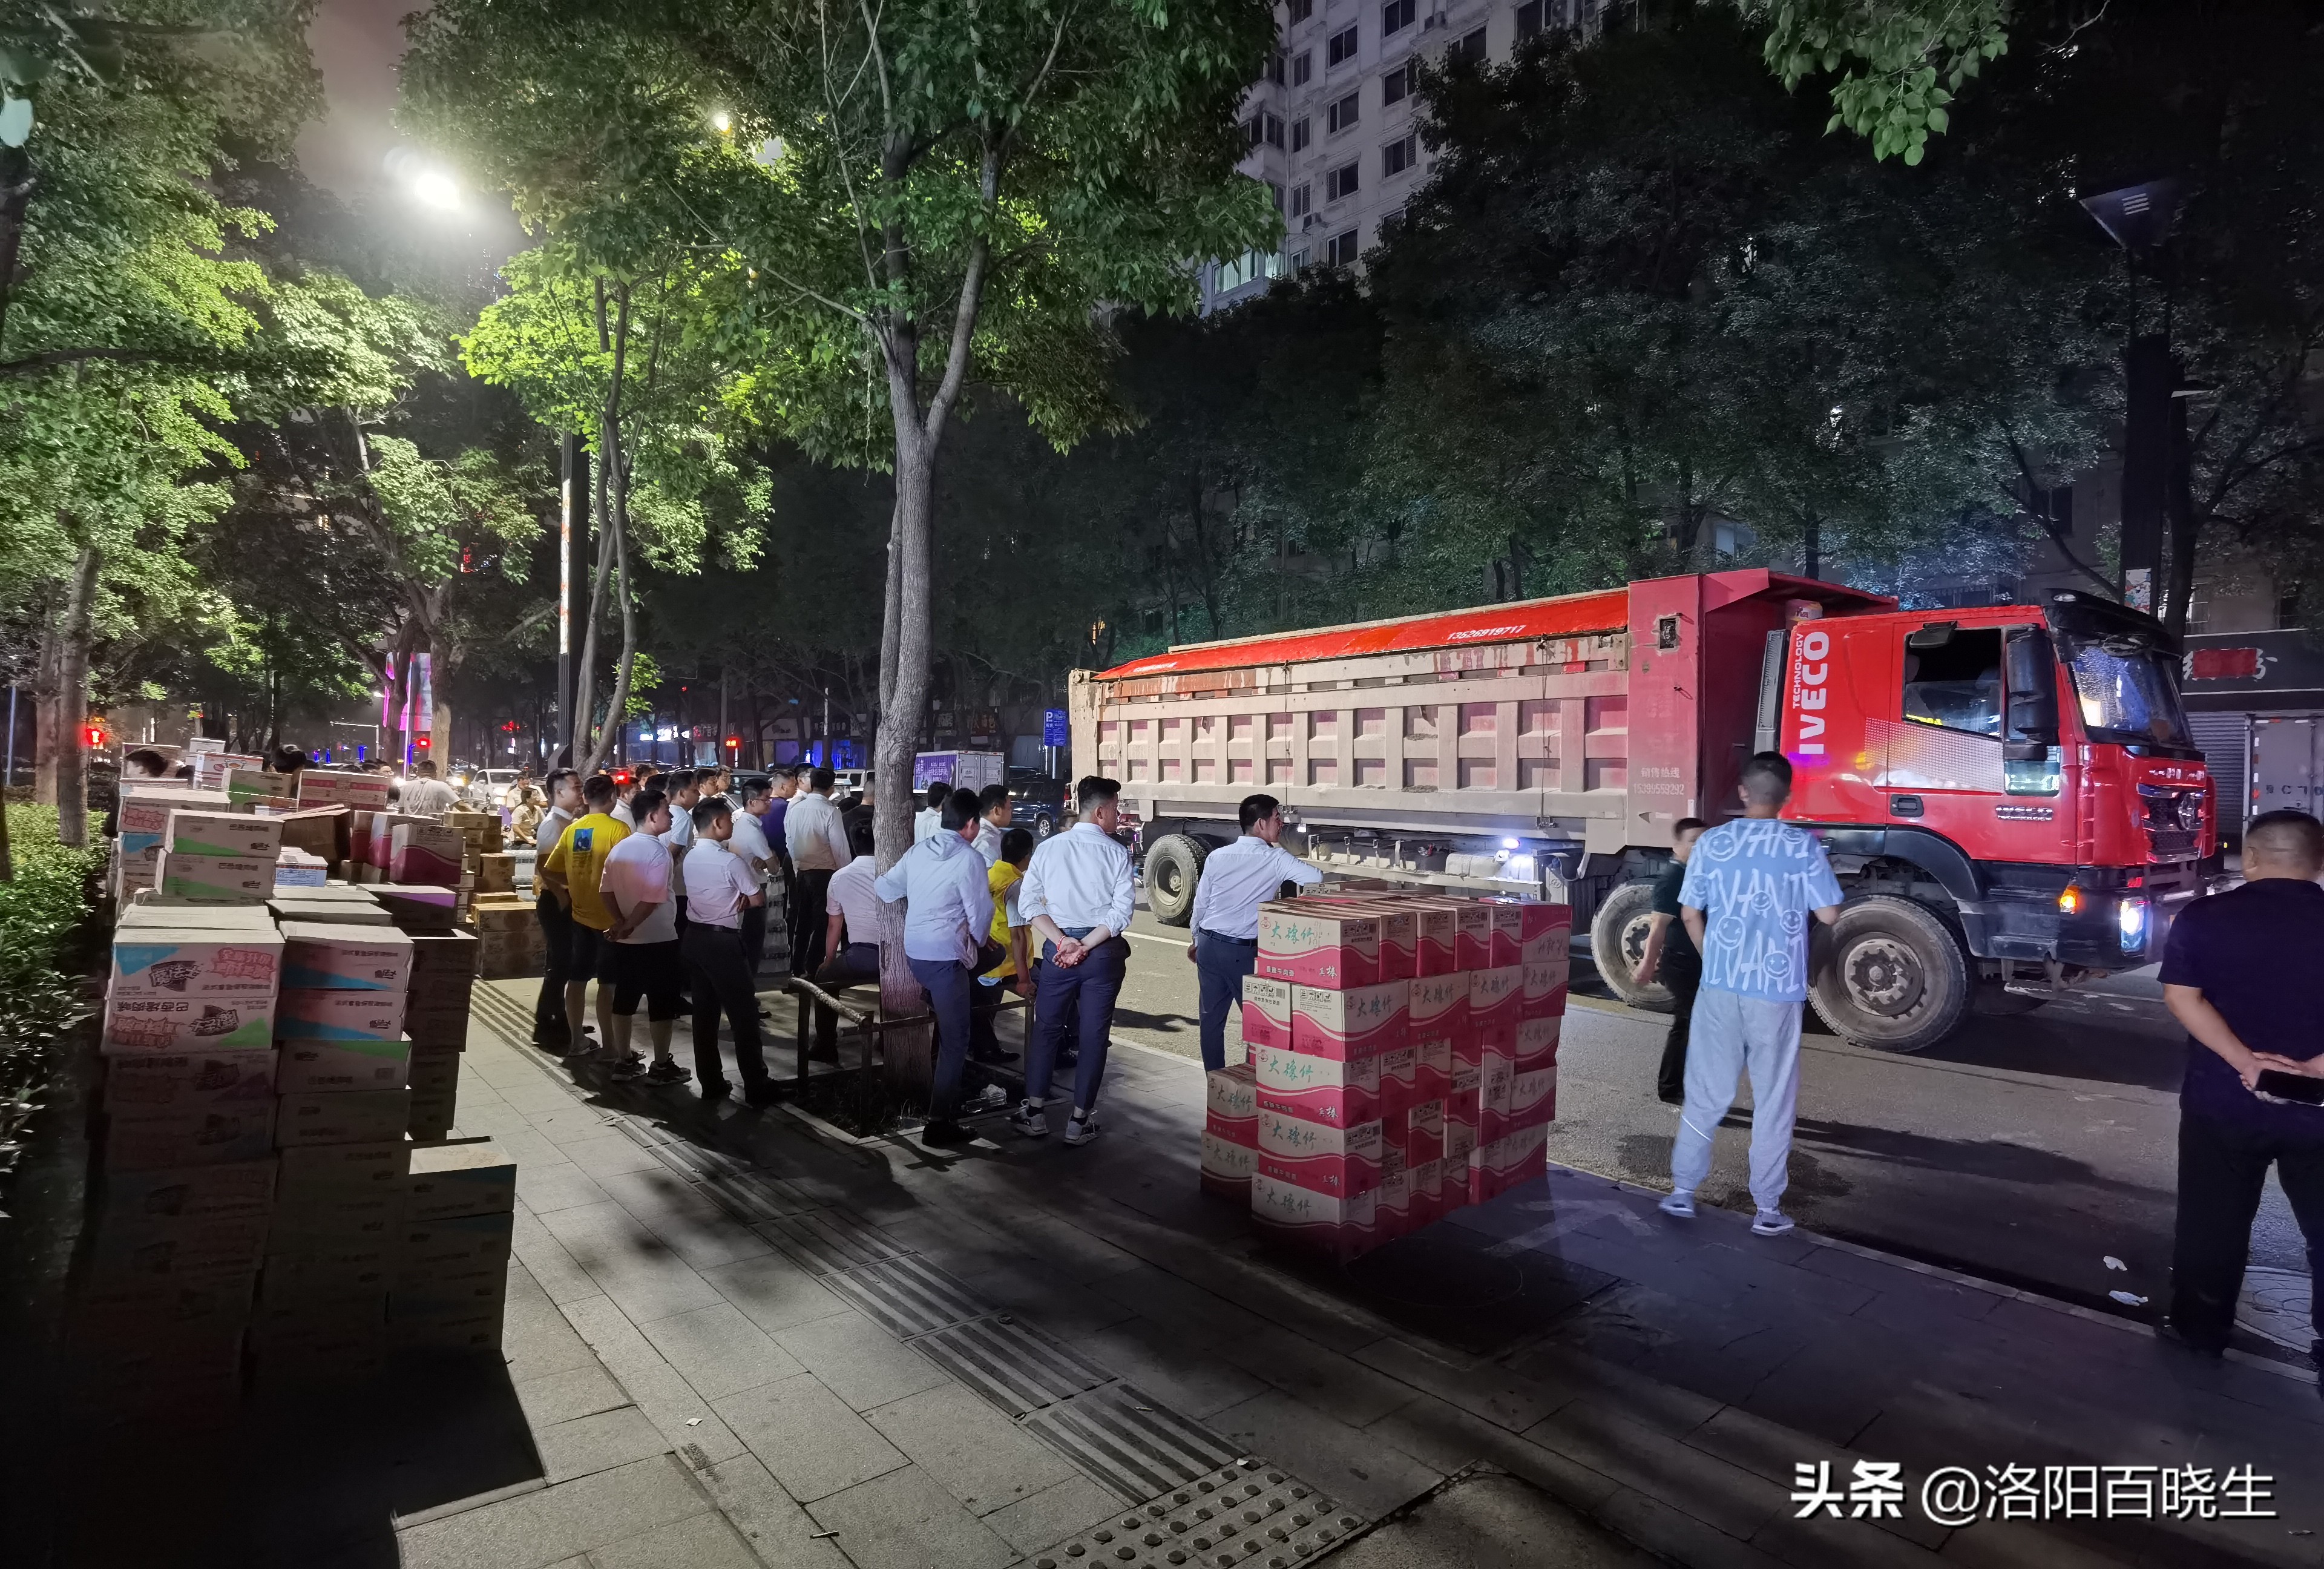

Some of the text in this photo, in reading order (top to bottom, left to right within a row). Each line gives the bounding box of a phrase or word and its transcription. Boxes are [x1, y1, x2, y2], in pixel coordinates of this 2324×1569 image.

[1446, 625, 1526, 640] 13526919717
[1793, 633, 1804, 709] TECHNOLOGY
[1799, 631, 1829, 754] IVECO
[1641, 767, 1681, 778] 销售热线
